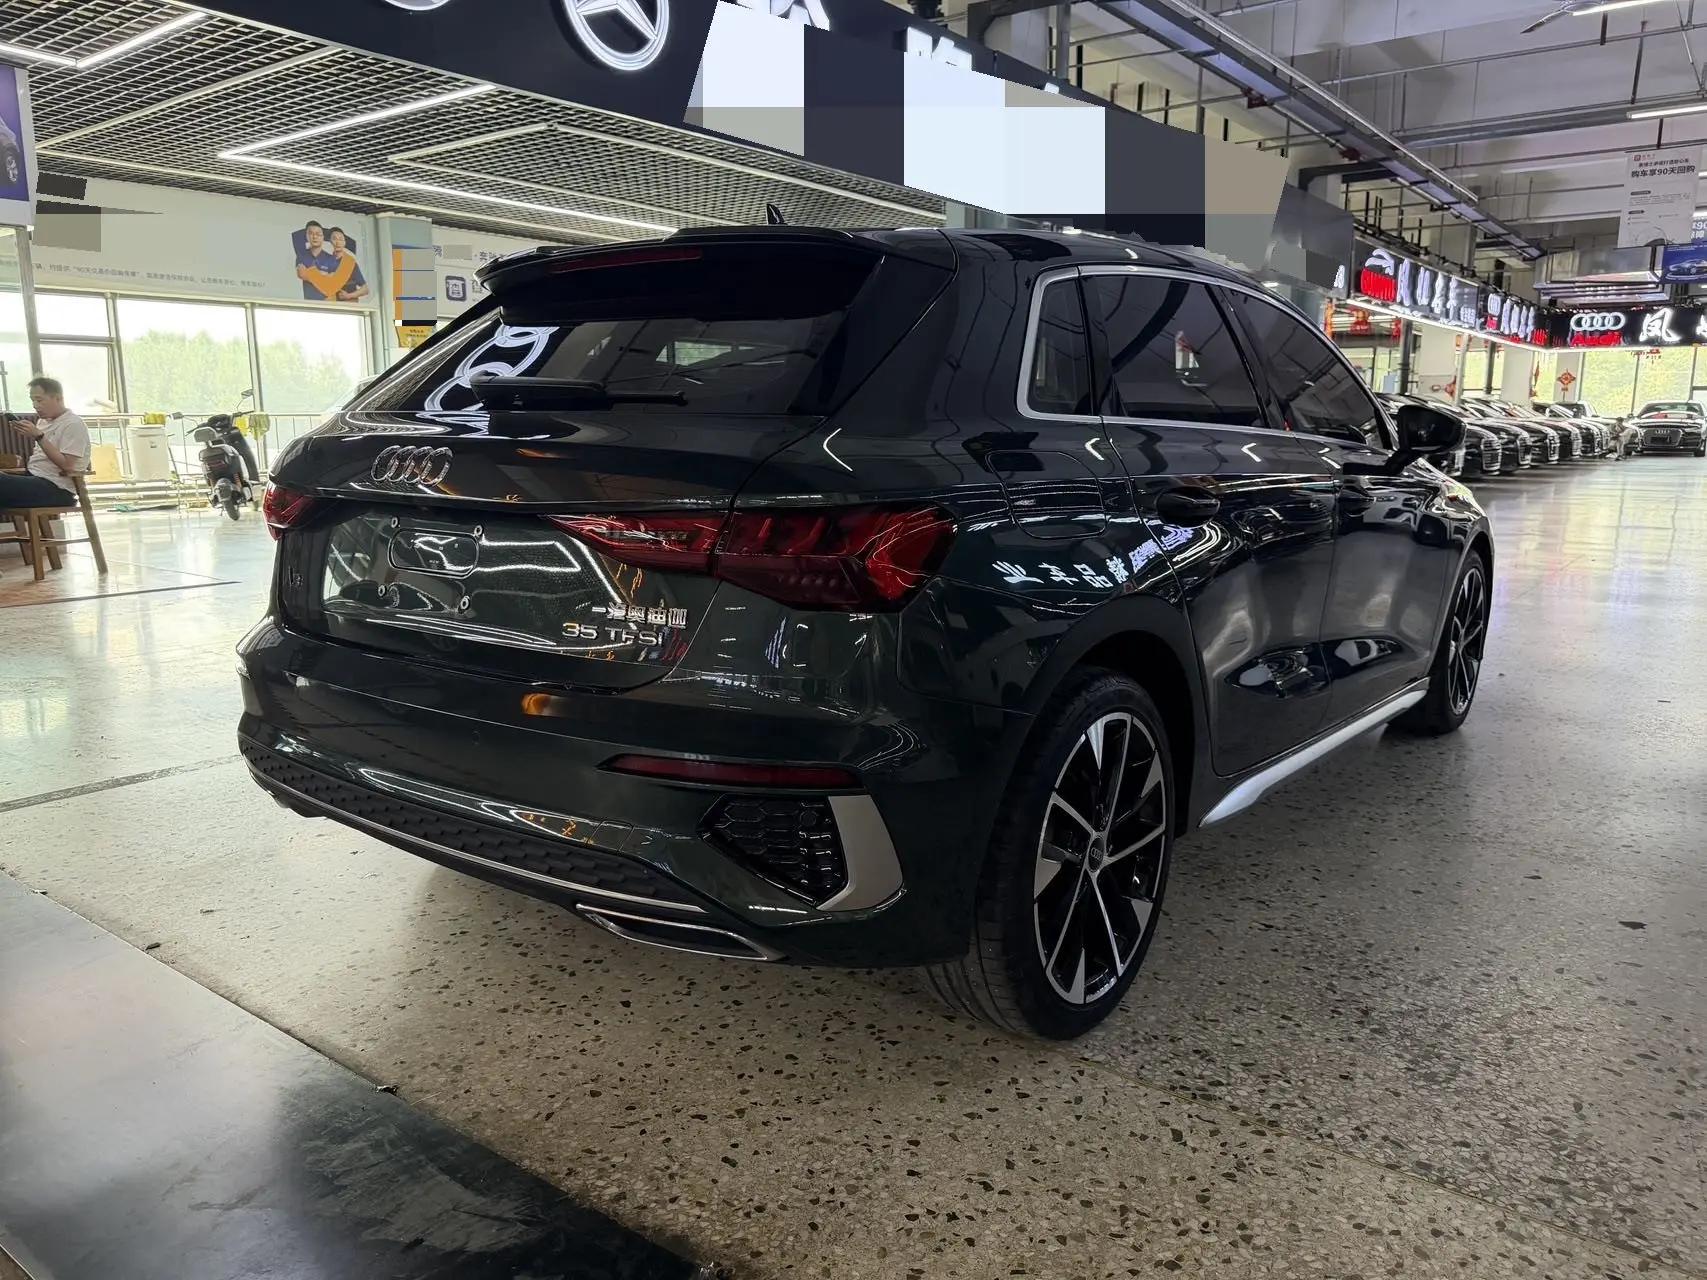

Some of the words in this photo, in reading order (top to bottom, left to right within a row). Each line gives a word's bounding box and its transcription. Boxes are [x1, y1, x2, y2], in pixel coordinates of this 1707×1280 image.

[1631, 165, 1696, 178] 购车享90天回购
[1571, 331, 1623, 347] Audi
[562, 622, 598, 640] 35
[604, 626, 664, 647] TFSI
